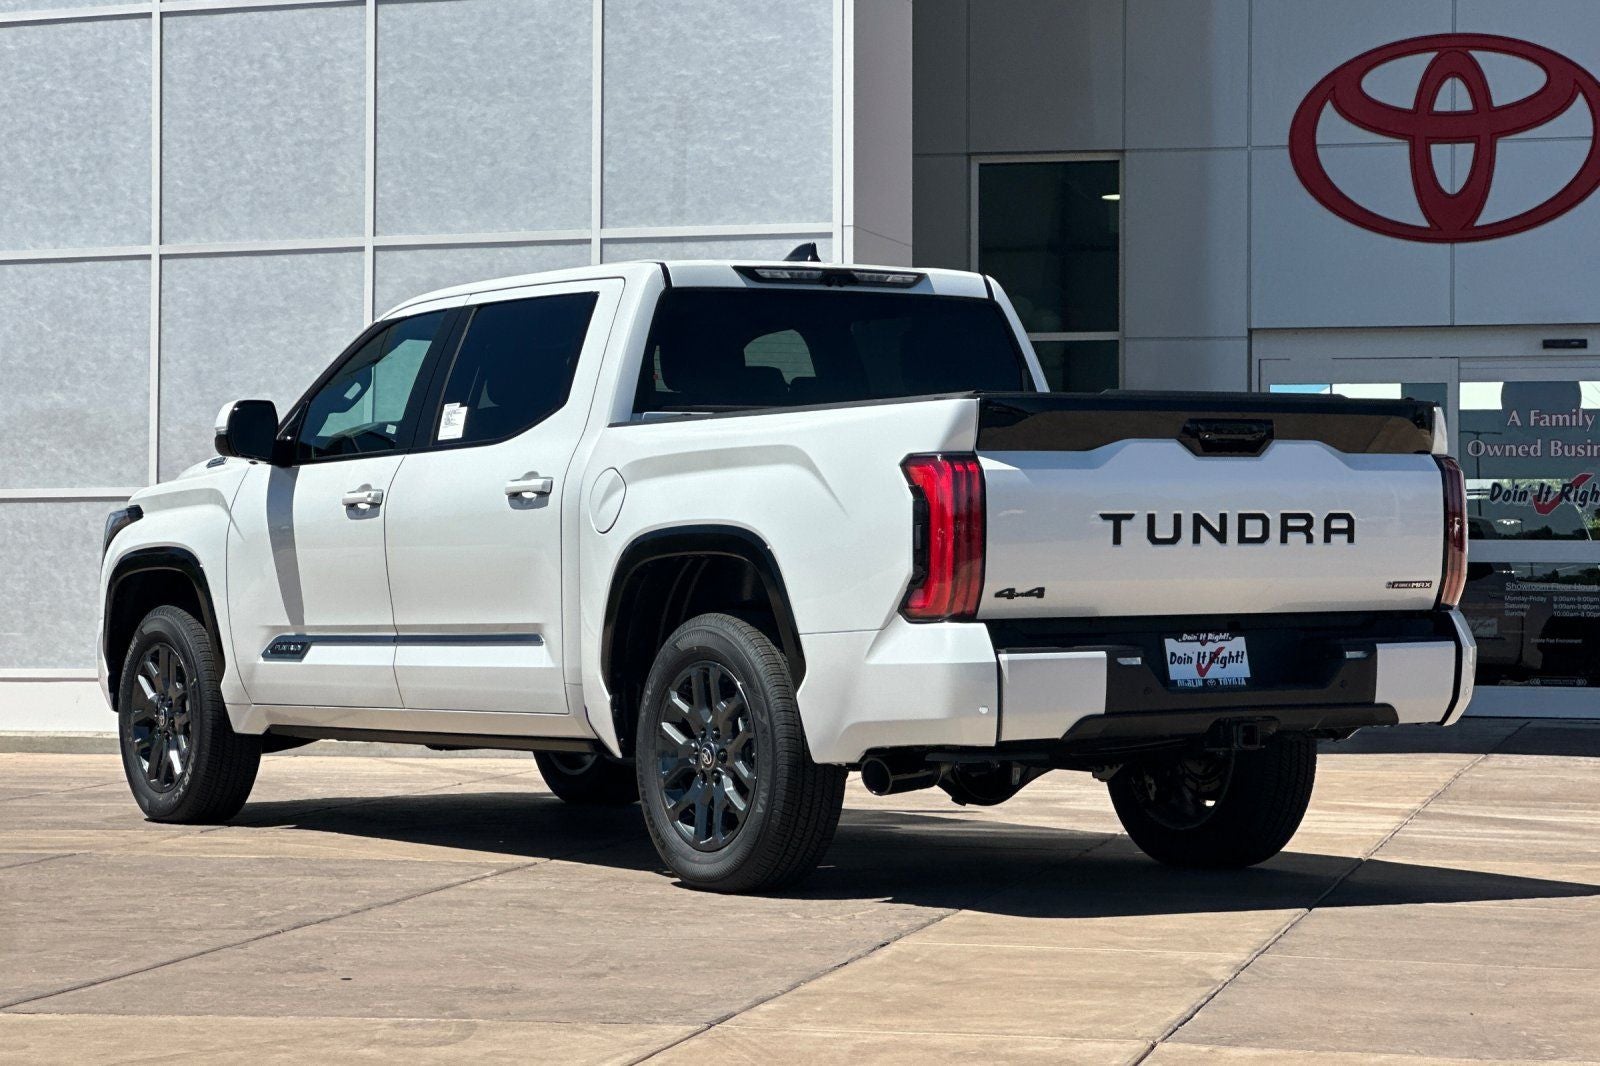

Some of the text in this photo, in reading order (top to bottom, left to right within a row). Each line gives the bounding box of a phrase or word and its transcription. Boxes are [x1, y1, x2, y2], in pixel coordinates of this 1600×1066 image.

[1507, 409, 1595, 432] A Family
[1467, 439, 1541, 457] Owned
[1536, 482, 1552, 503] It
[1099, 512, 1355, 546] TUNDRA
[1196, 651, 1207, 664] It
